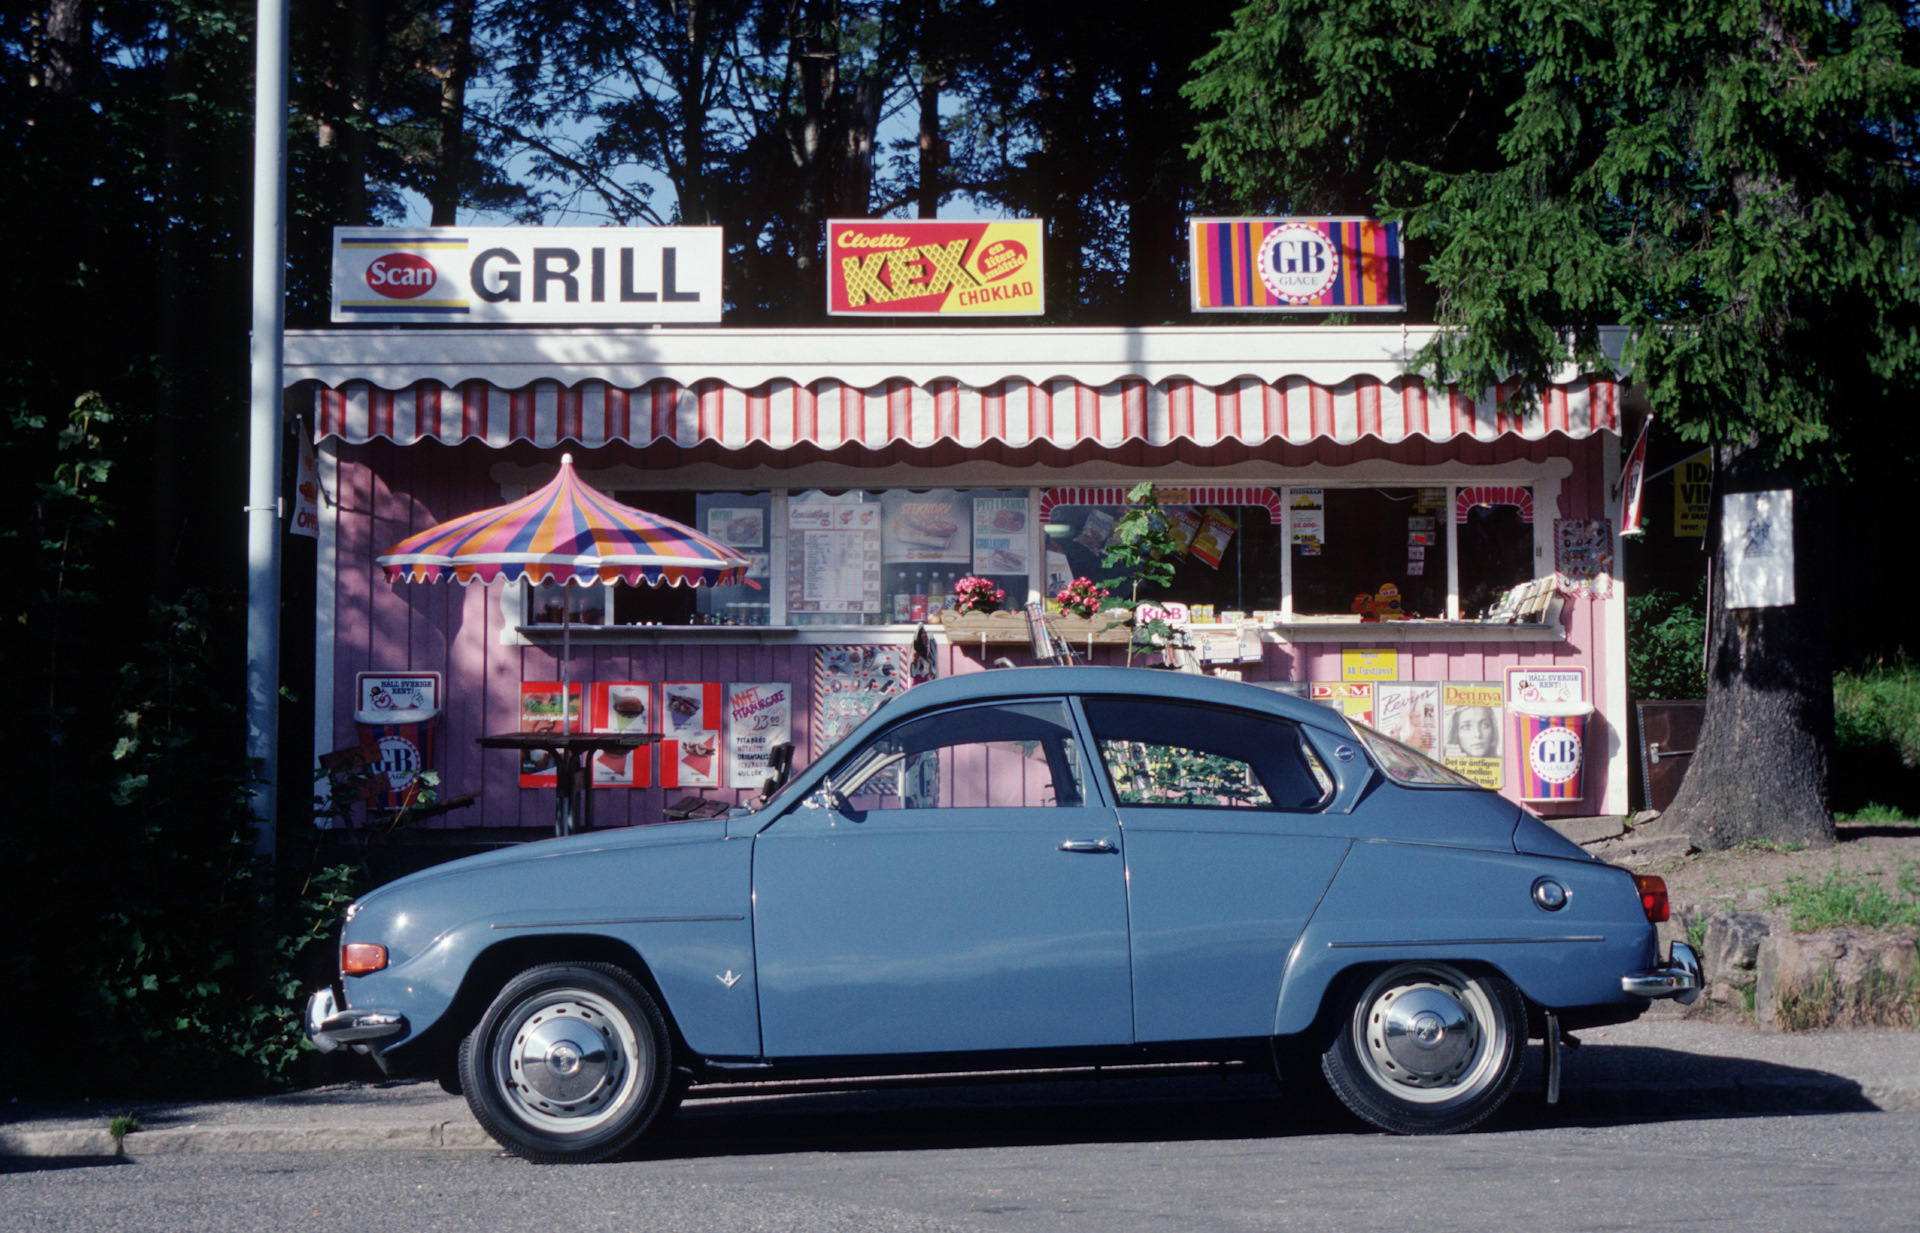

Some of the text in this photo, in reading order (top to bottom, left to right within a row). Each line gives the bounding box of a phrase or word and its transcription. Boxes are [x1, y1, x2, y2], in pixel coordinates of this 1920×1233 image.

[838, 230, 910, 248] Cloetta
[984, 249, 1015, 270] liten
[988, 244, 1005, 255] en
[1272, 241, 1325, 274] GB
[371, 261, 432, 286] Scan
[470, 247, 701, 303] GRILL
[842, 239, 981, 307] KEX
[986, 254, 1026, 281] måltid
[1279, 276, 1319, 286] GLACE
[959, 281, 1033, 306] CHOKLAD
[900, 502, 953, 515] STEKKORV
[1347, 666, 1394, 677] AB Tipstjänst
[730, 686, 760, 710] NYHET
[1313, 686, 1371, 697] DAM
[1446, 687, 1502, 706] Den nya
[1381, 689, 1437, 715] Revyn
[1538, 740, 1576, 763] GB
[1445, 758, 1458, 766] Det
[1469, 758, 1500, 770] äntligen
[1466, 768, 1493, 776] mellan
[1480, 778, 1498, 788] mig!
